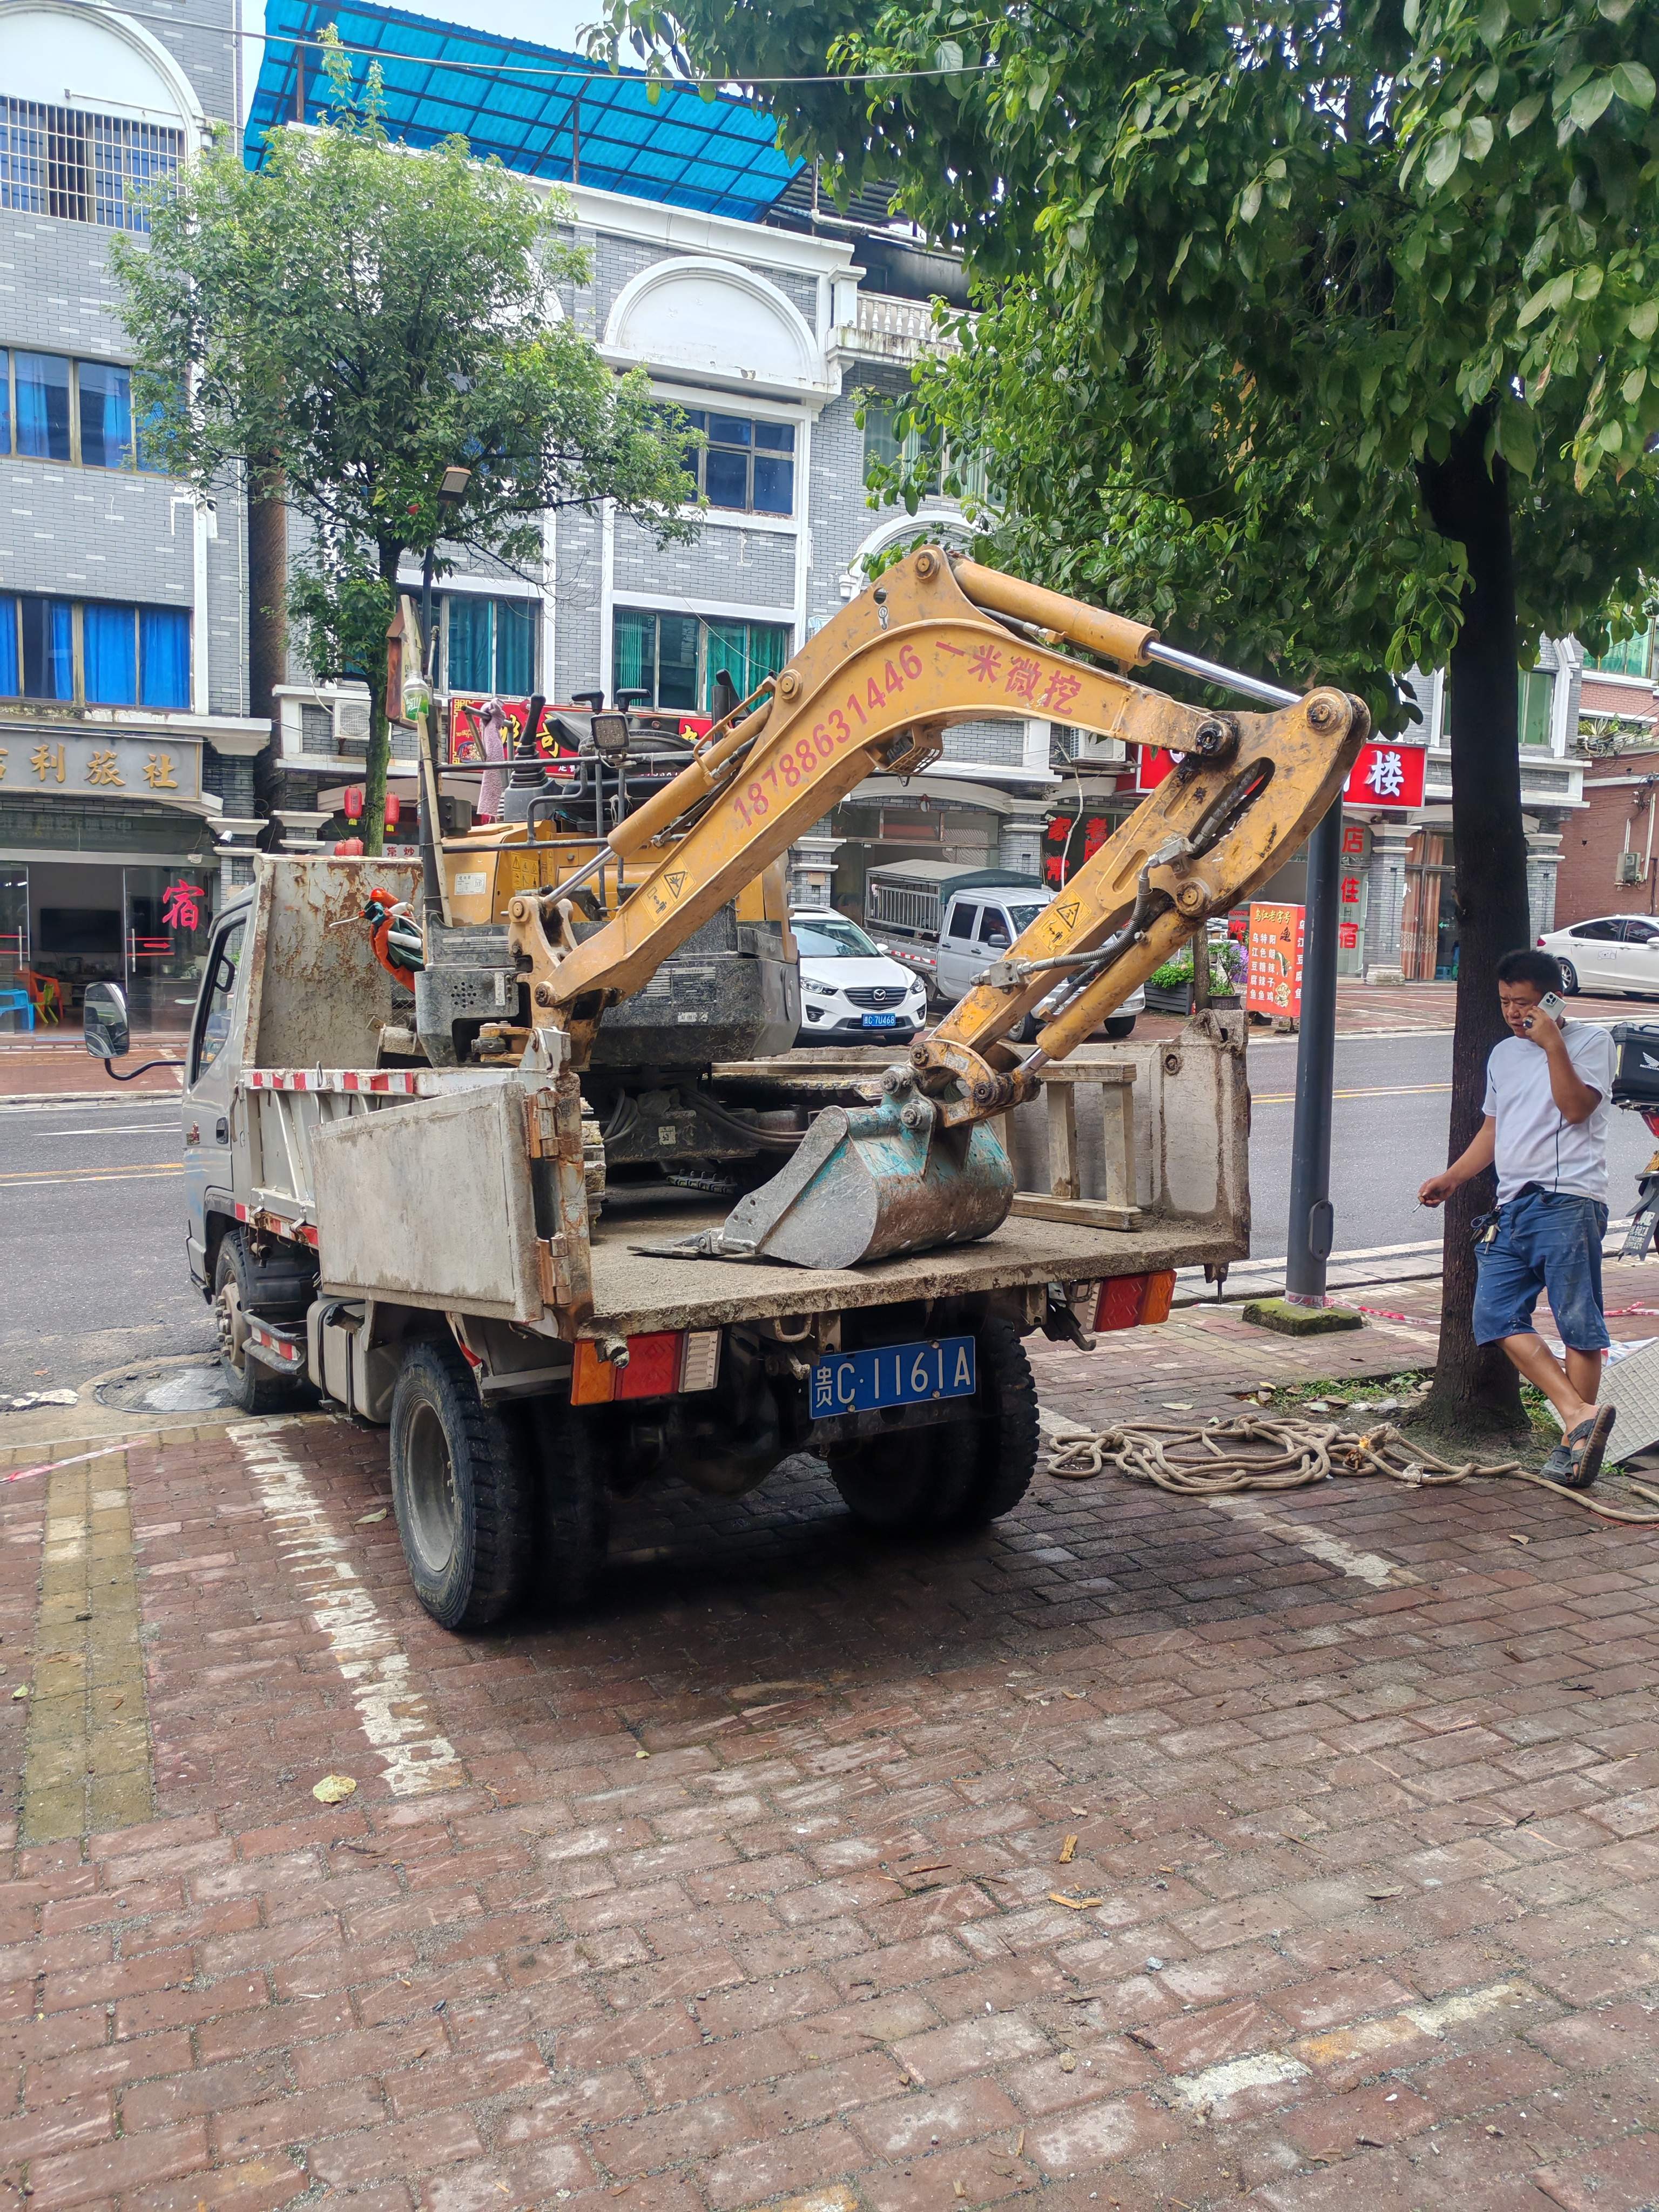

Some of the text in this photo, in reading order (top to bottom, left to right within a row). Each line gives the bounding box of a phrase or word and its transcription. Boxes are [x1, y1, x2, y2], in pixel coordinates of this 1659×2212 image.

[935, 641, 1082, 716] 一米微挖
[733, 644, 922, 826] 18788631446
[162, 879, 205, 931] 宿
[1255, 907, 1291, 925] 乌江老字号
[815, 1346, 971, 1408] 贵C·1161A
